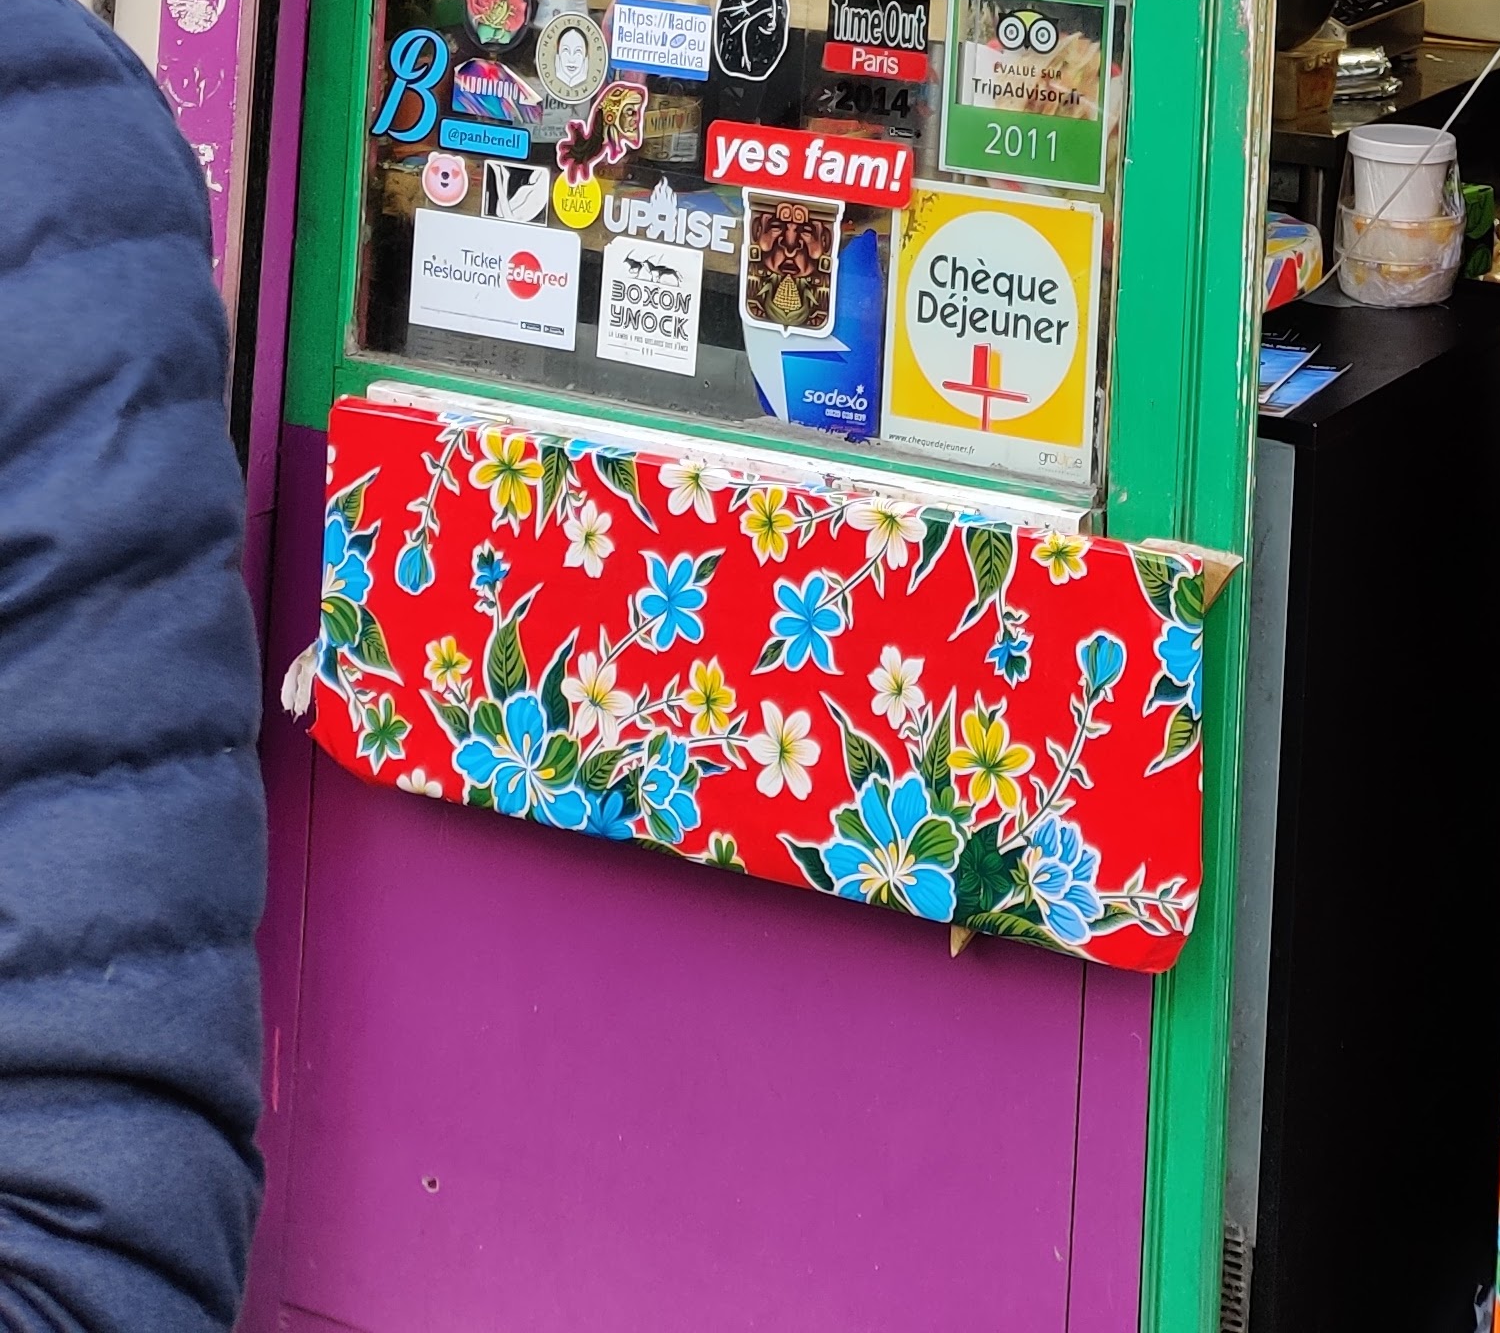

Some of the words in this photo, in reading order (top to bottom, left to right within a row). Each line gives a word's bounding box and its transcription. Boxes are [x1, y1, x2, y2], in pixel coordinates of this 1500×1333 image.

[884, 0, 926, 51] Out
[851, 46, 899, 75] Paris
[993, 60, 1036, 78] ÉVALUÉ
[1041, 67, 1062, 79] SUR
[834, 83, 912, 119] 2014
[972, 77, 1081, 106] TripAdvisor.fr
[984, 122, 1058, 162] 2011
[712, 135, 791, 179] yes
[803, 137, 907, 193] fam!
[603, 194, 738, 254] UPRISE
[423, 259, 501, 288] Restaurant
[461, 248, 503, 270] Ticket
[506, 262, 568, 288] Edenred
[929, 253, 1059, 307] Chèque
[611, 279, 692, 315] BOXON
[917, 289, 1070, 346] Déjeuner
[802, 388, 868, 410] sodexo
[888, 432, 976, 455] www.chequedejeuner.fr
